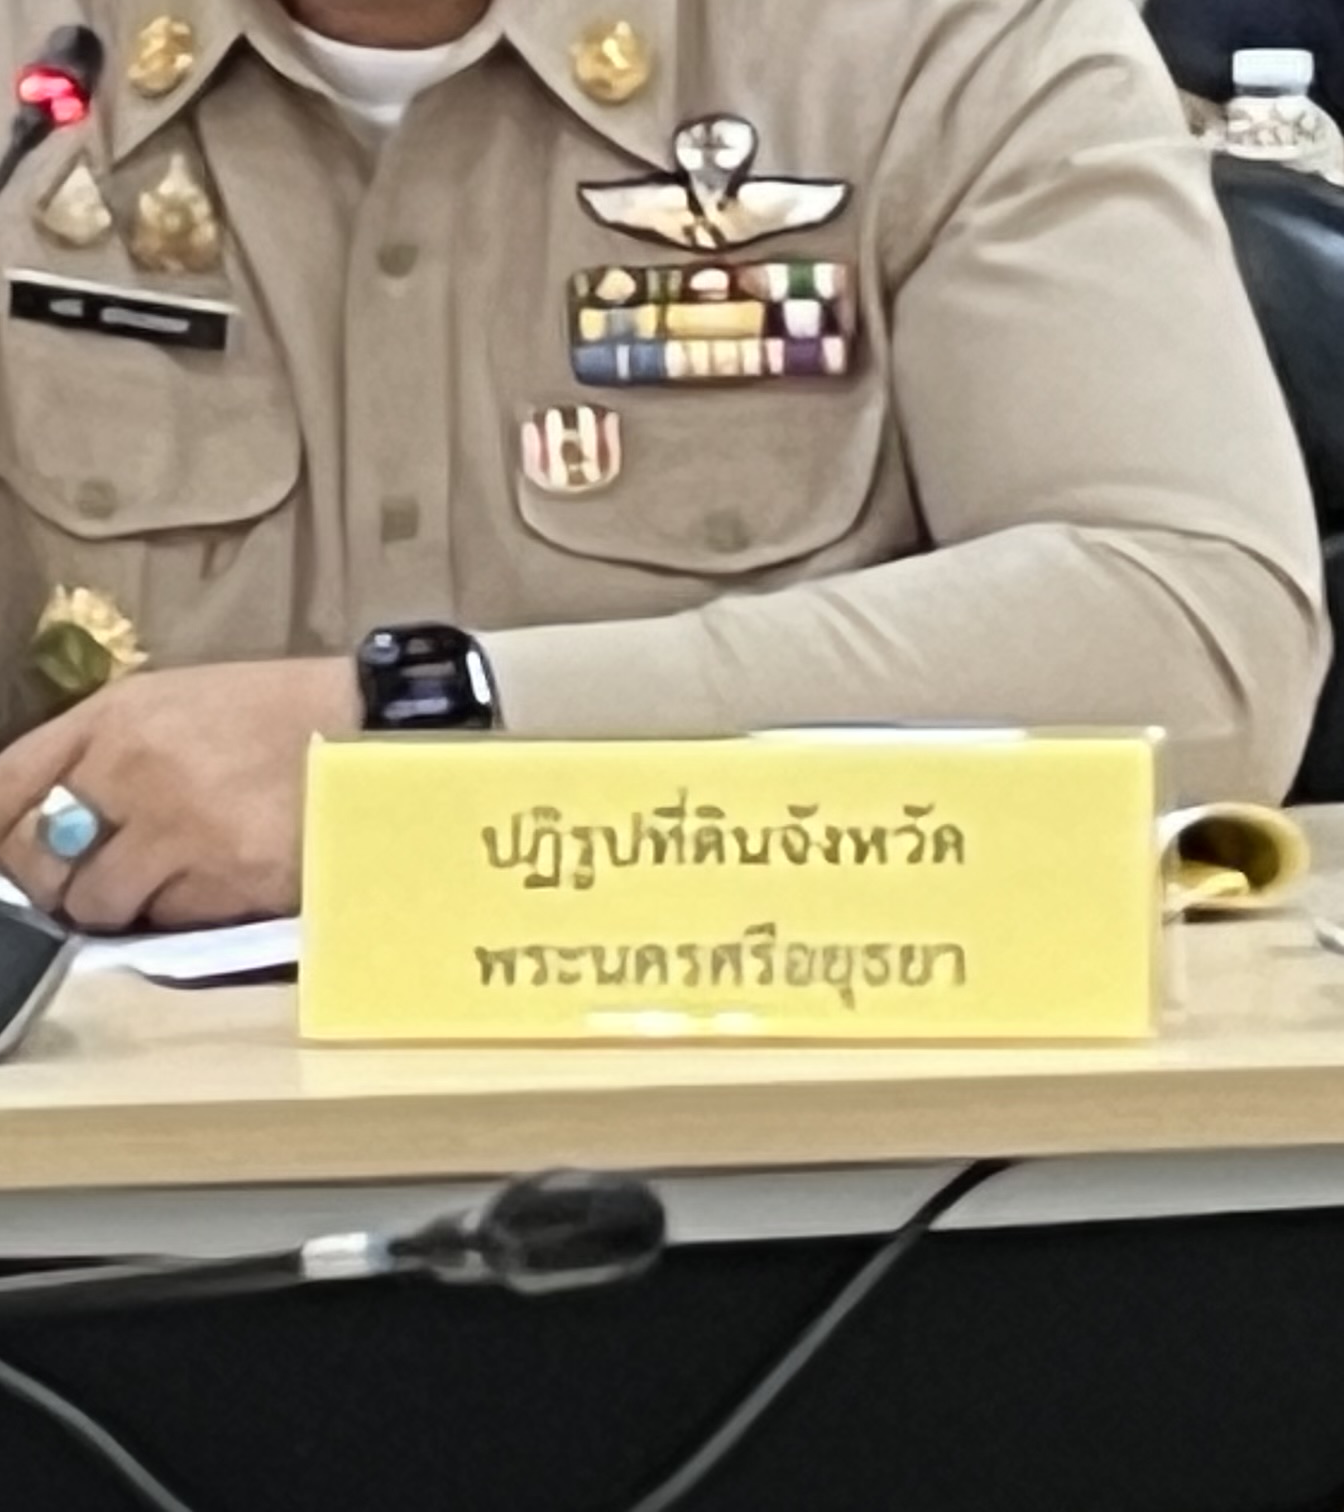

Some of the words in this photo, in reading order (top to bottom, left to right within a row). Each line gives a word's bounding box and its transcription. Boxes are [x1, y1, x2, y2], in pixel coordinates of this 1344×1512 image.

[481, 787, 964, 889] ปฏิรูปที่ดินจังหวัด
[474, 922, 965, 1011] พระนครศรีอยุธยา
